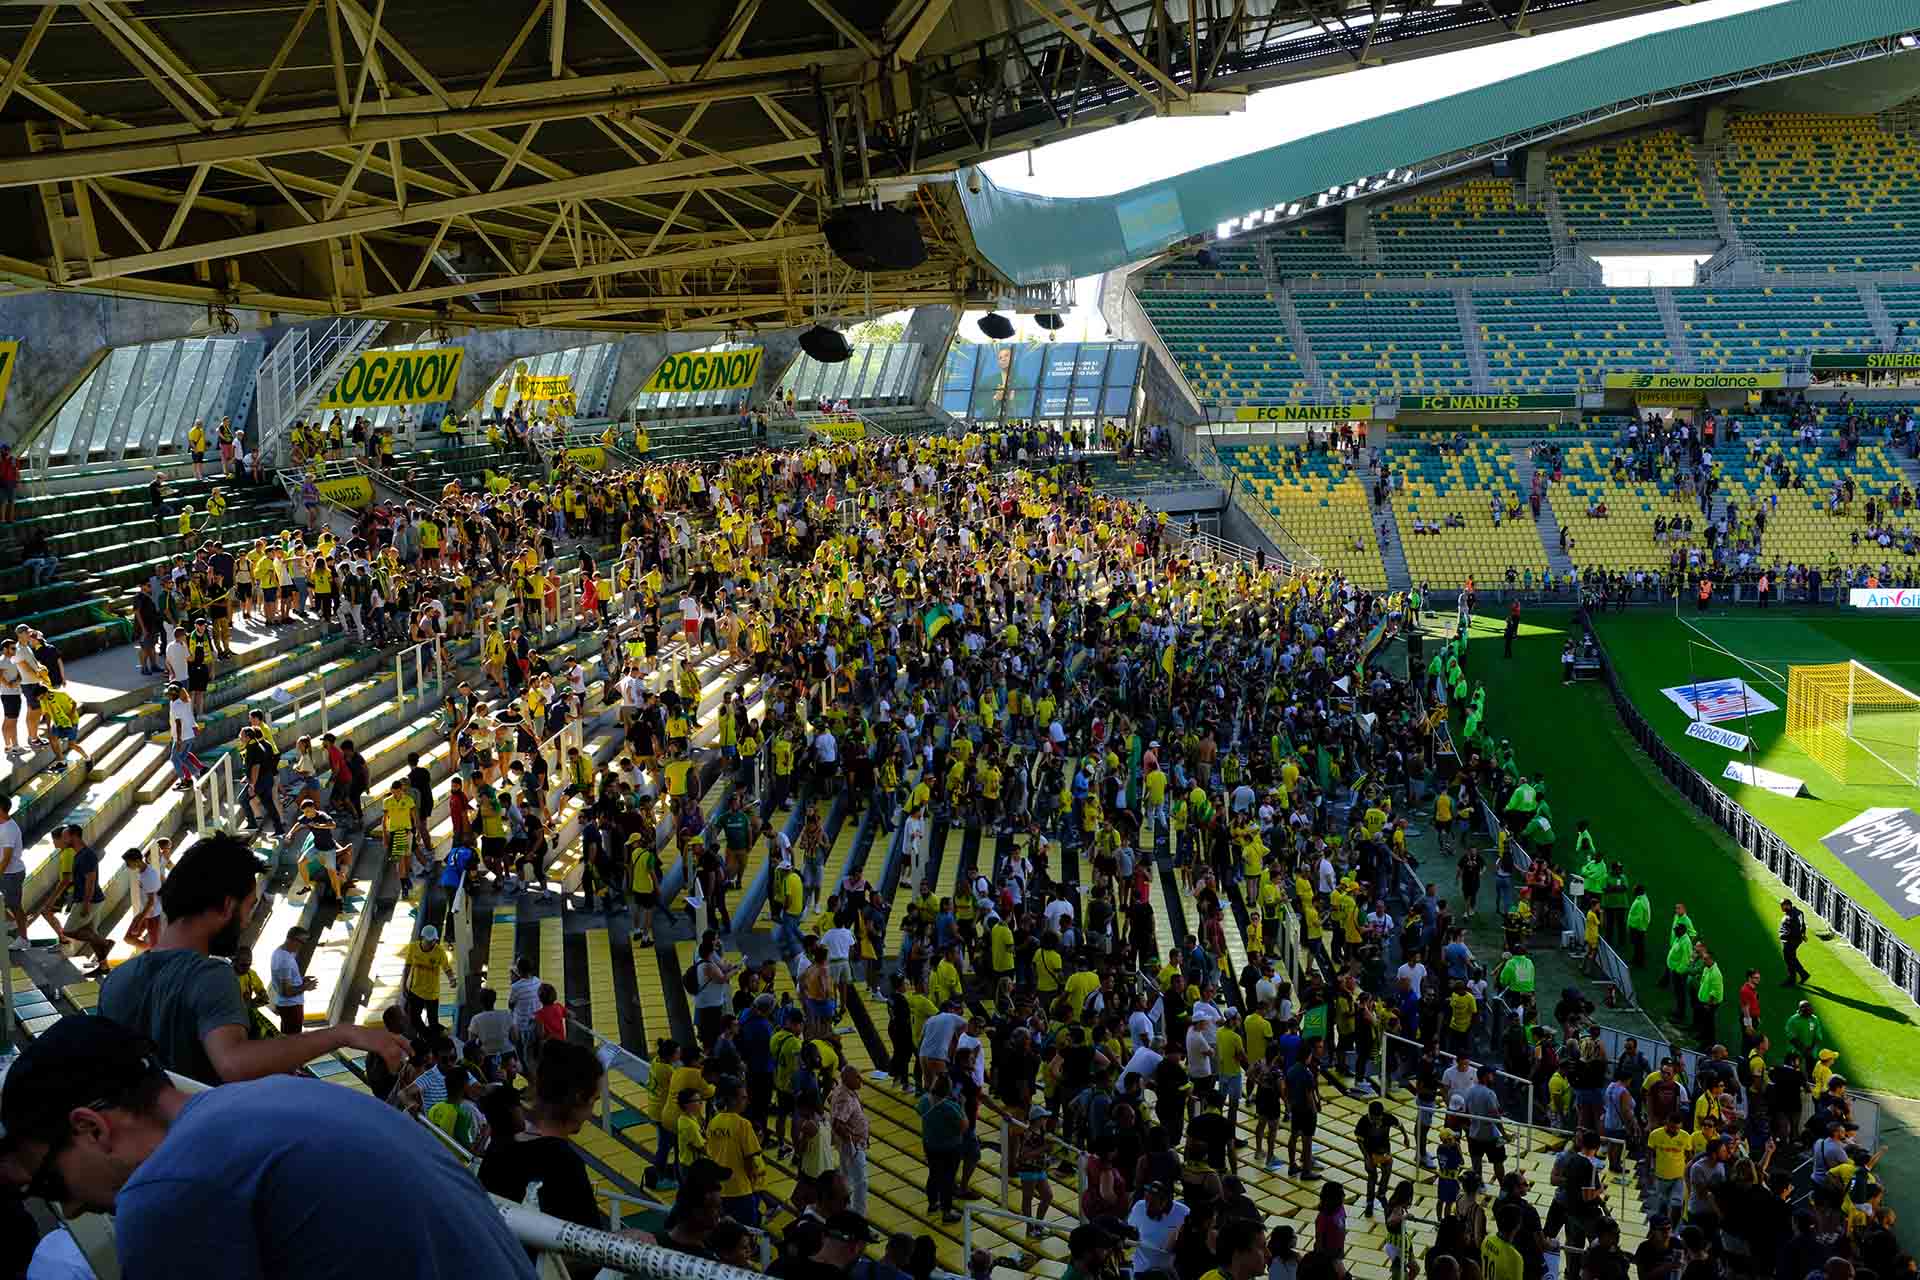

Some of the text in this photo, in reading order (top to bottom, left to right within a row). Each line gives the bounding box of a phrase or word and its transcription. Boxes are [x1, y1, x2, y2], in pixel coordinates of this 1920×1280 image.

[1659, 376, 1690, 387] new
[1694, 374, 1758, 387] balance
[1421, 396, 1520, 409] FC NANTES
[1257, 406, 1351, 420] FC NANTES
